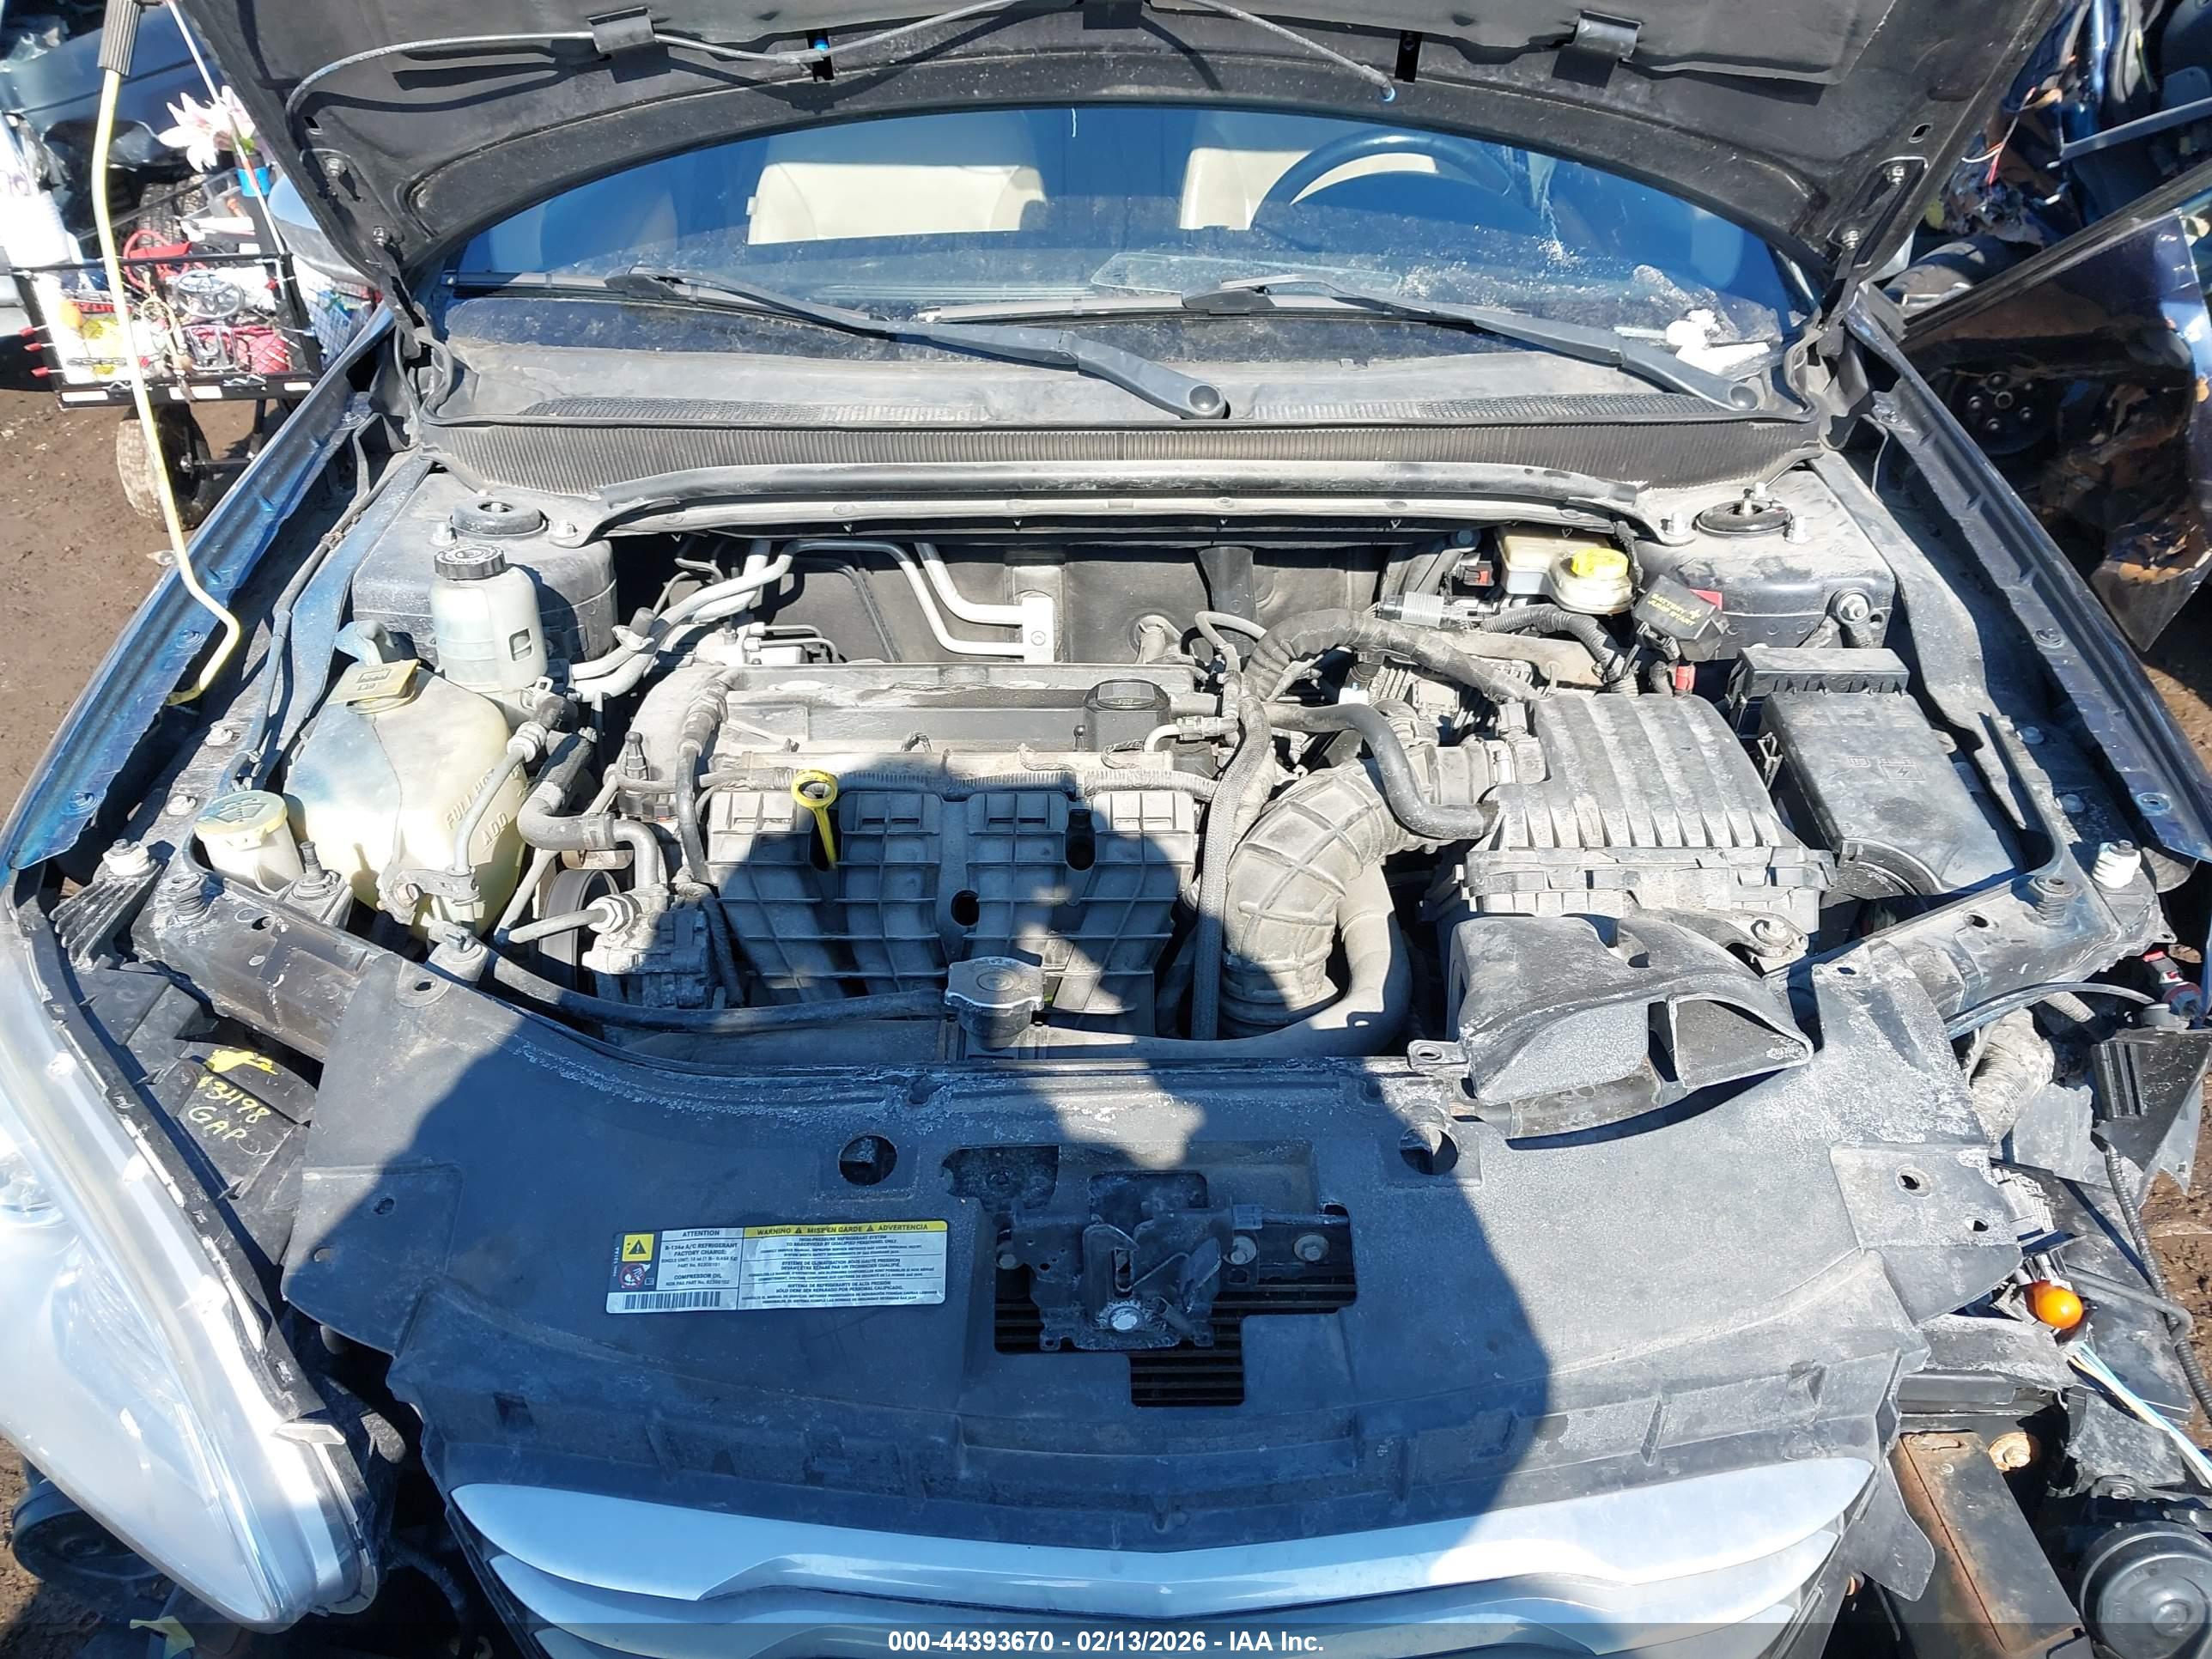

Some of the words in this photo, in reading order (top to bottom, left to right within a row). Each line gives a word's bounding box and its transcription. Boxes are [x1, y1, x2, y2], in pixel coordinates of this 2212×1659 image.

[1647, 599, 1670, 612] JUMP
[1669, 611, 1697, 626] START
[1650, 592, 1686, 614] BATTERY
[481, 811, 509, 846] ADD
[187, 1106, 248, 1141] GAP
[757, 1227, 792, 1236] WARNING
